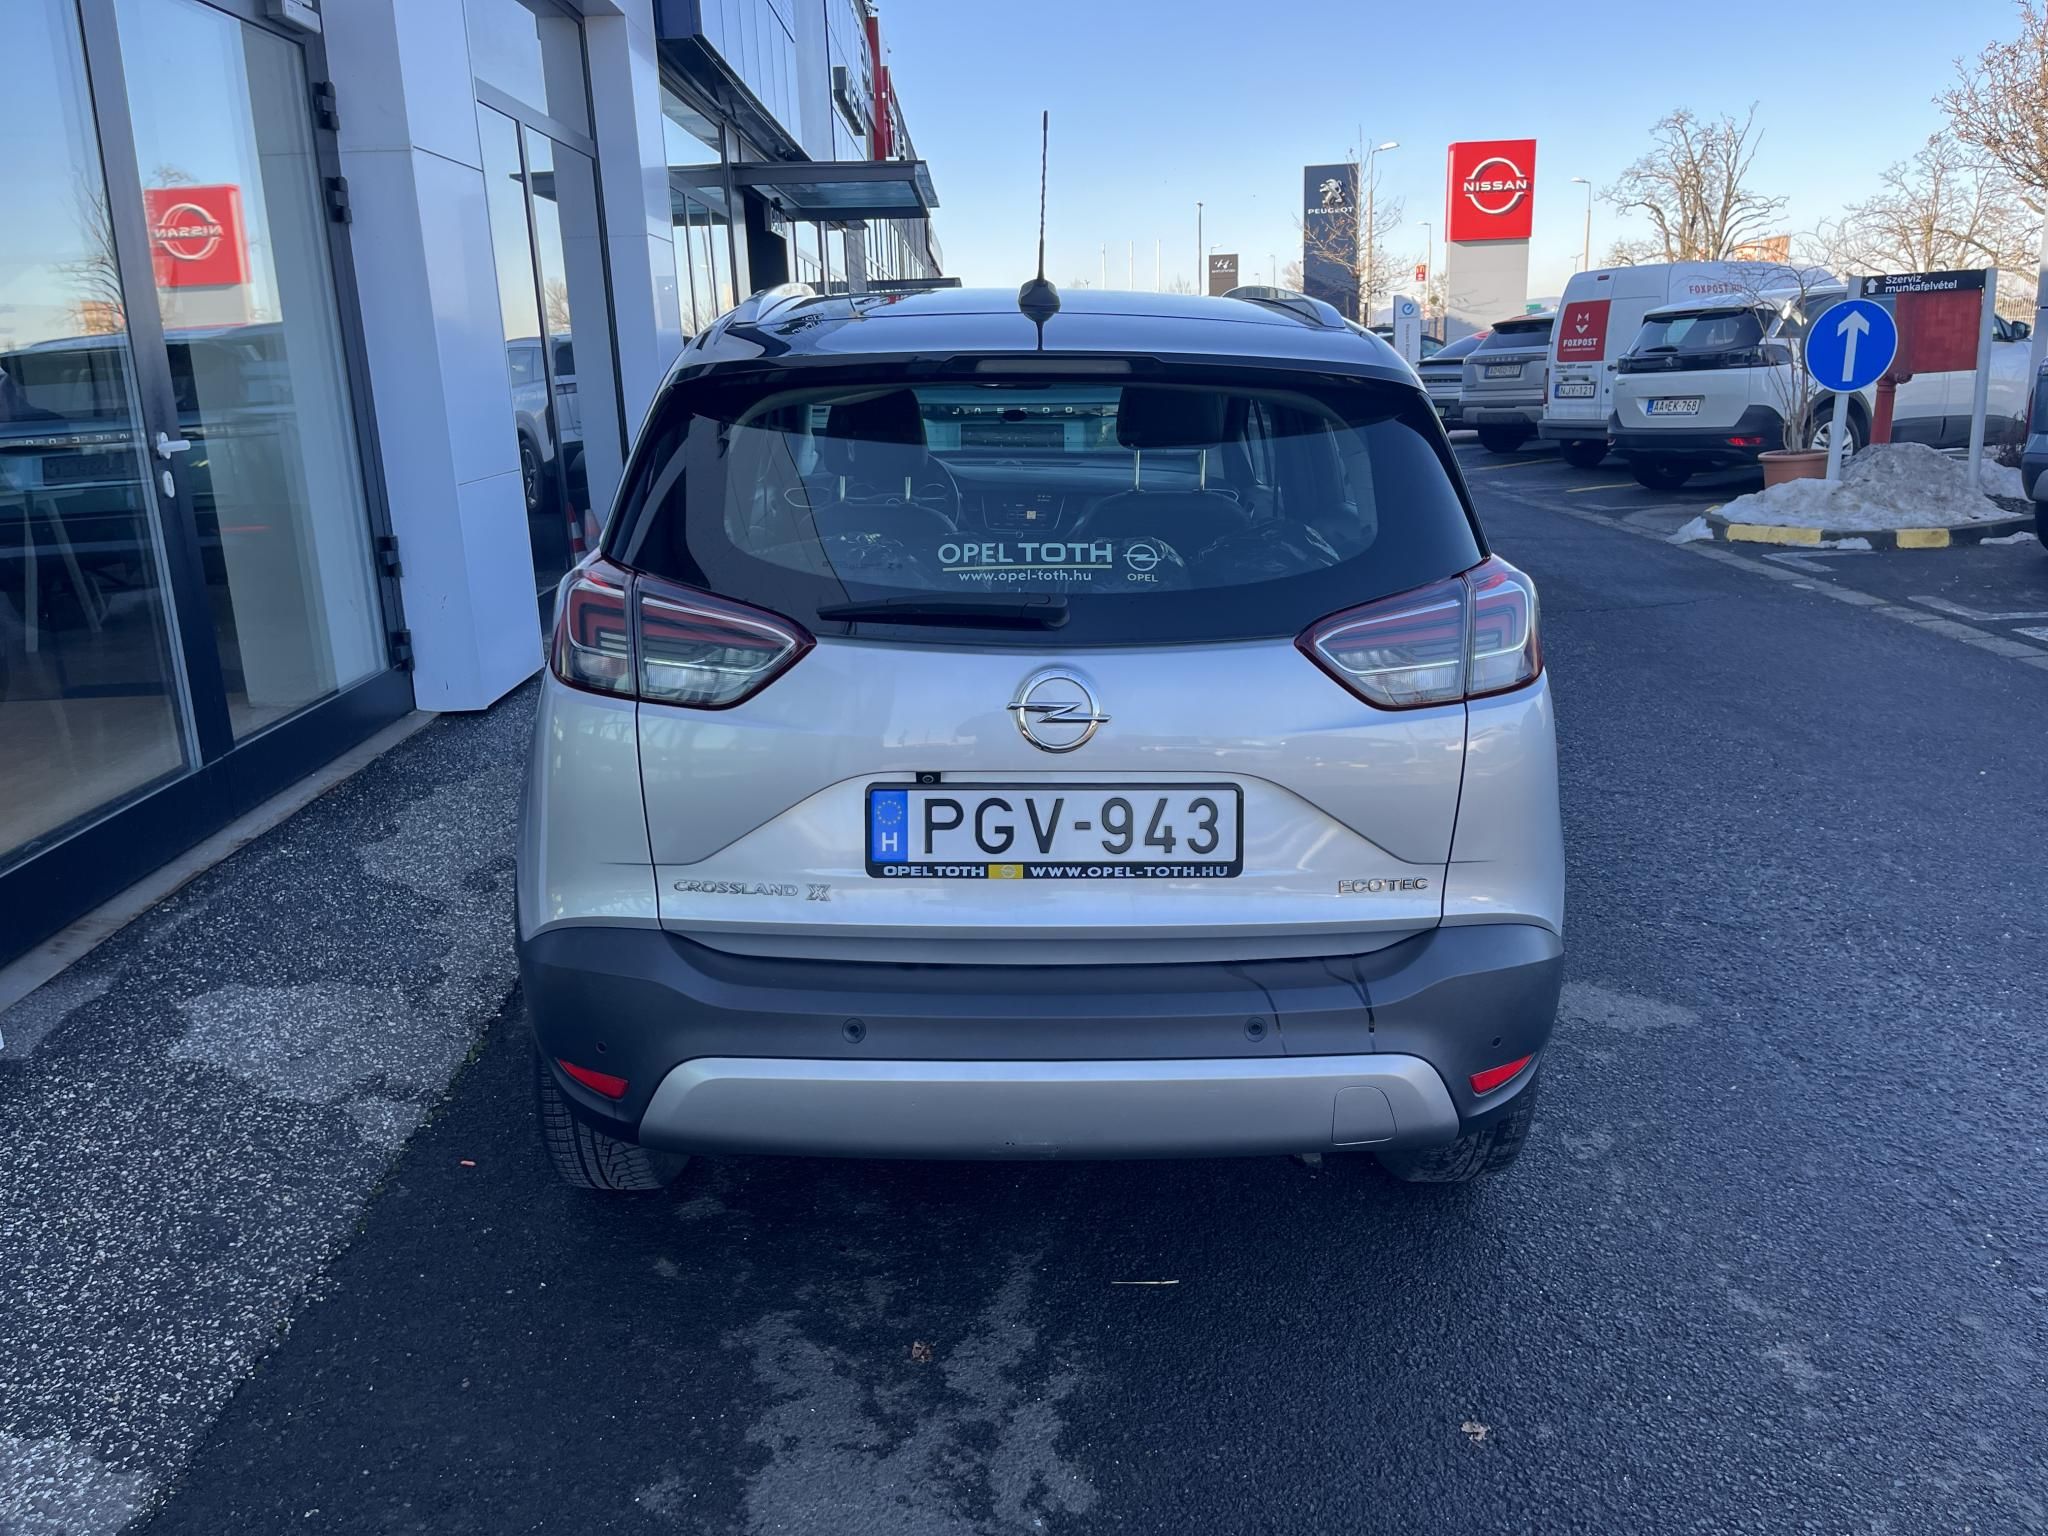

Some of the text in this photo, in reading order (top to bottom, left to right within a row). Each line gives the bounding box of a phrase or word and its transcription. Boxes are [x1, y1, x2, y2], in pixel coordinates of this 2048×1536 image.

[1463, 180, 1527, 192] NISSAN
[1885, 275, 1922, 285] Szerviz
[1885, 280, 1957, 293] munkafelvétel
[1563, 338, 1598, 347] FOXPOST
[938, 543, 1113, 564] OPEL TOTH
[958, 569, 1092, 583] www.opel-toth.hu
[1127, 573, 1158, 582] OPEL
[923, 797, 1220, 855] PGV-943
[881, 832, 898, 852] H
[883, 866, 985, 877] OPEL TOTH
[1030, 866, 1229, 877] WWW.OPEL-TOTH.HU
[673, 880, 832, 901] CROSSLAND X
[1338, 878, 1429, 894] ECOTEC
